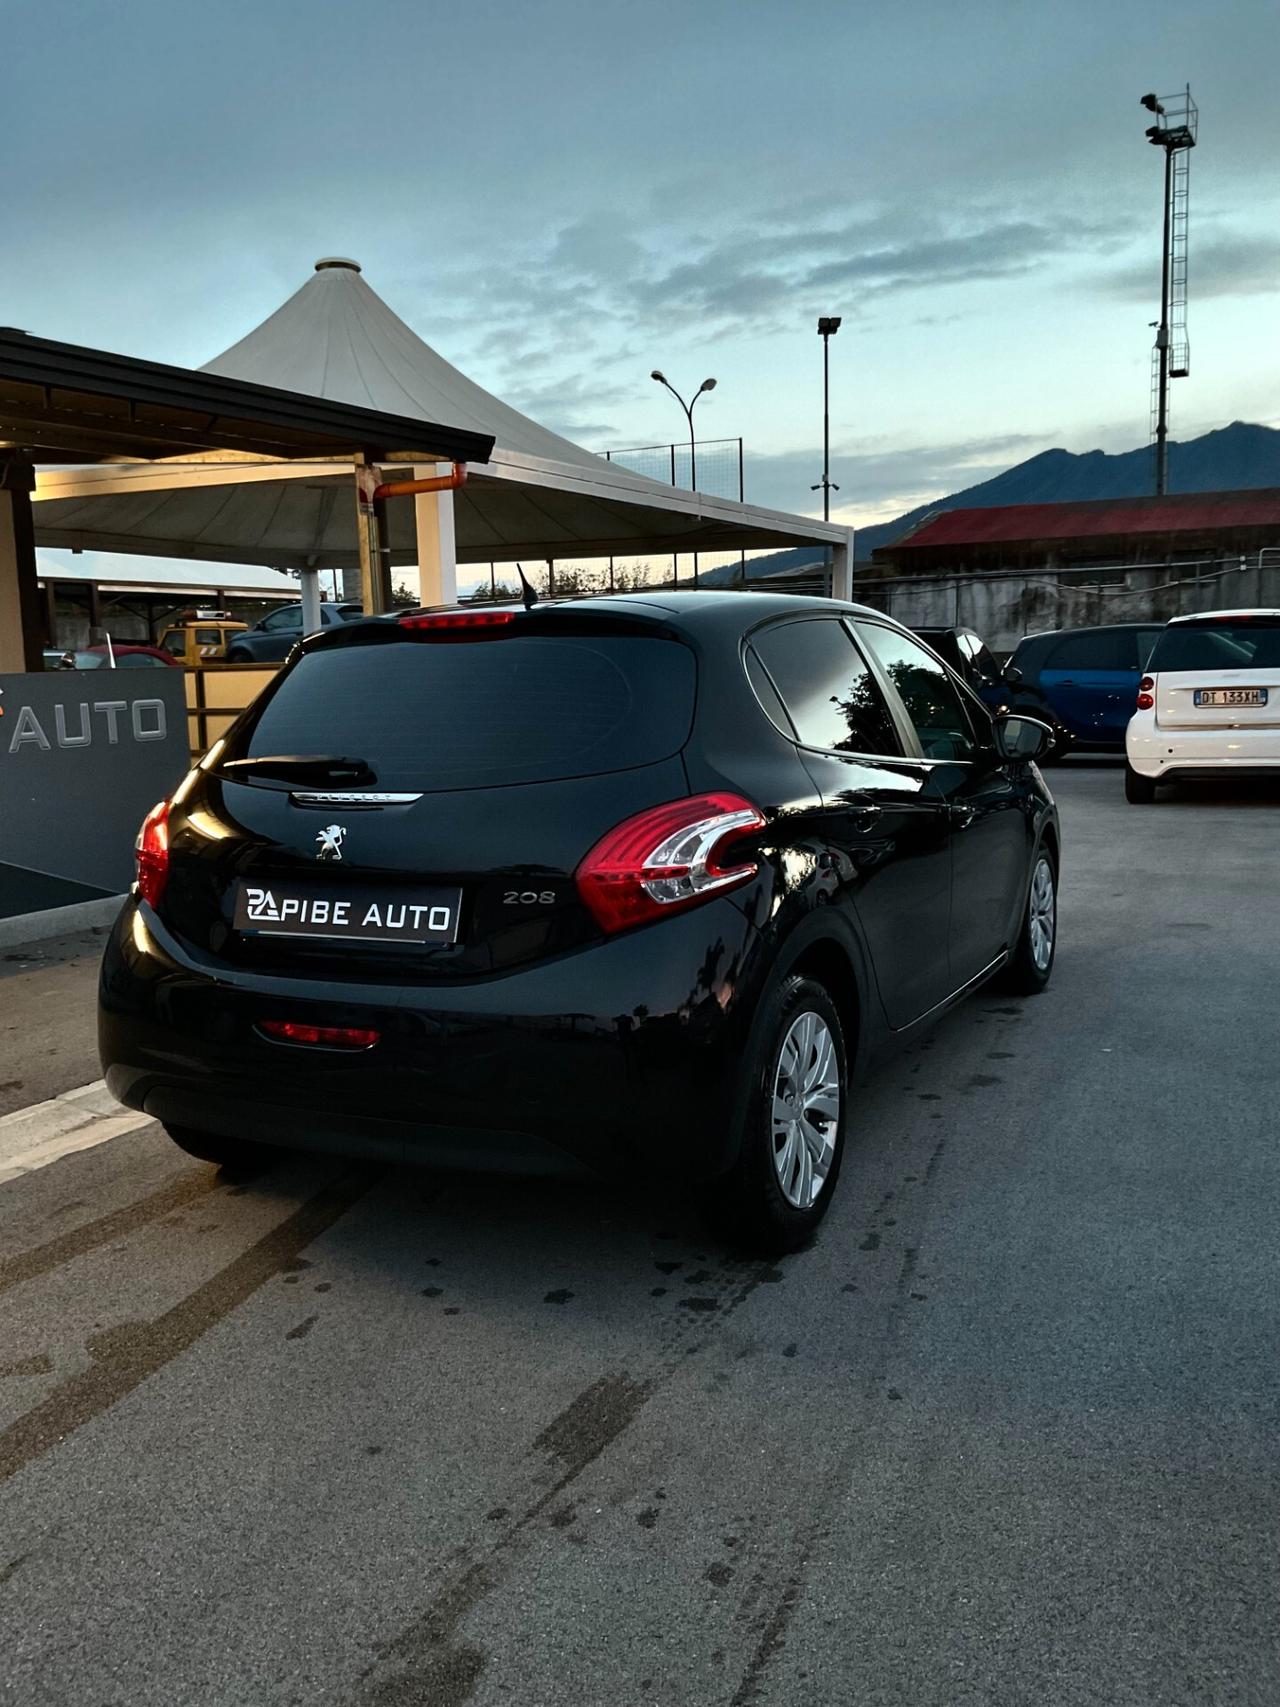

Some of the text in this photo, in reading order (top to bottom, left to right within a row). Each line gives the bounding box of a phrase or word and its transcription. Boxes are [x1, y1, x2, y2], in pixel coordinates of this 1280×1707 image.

[1202, 690, 1259, 703] DT 133XH
[8, 698, 167, 753] AUTO
[503, 891, 556, 904] 208
[280, 899, 351, 925] PIBE
[361, 903, 450, 930] AUTO
